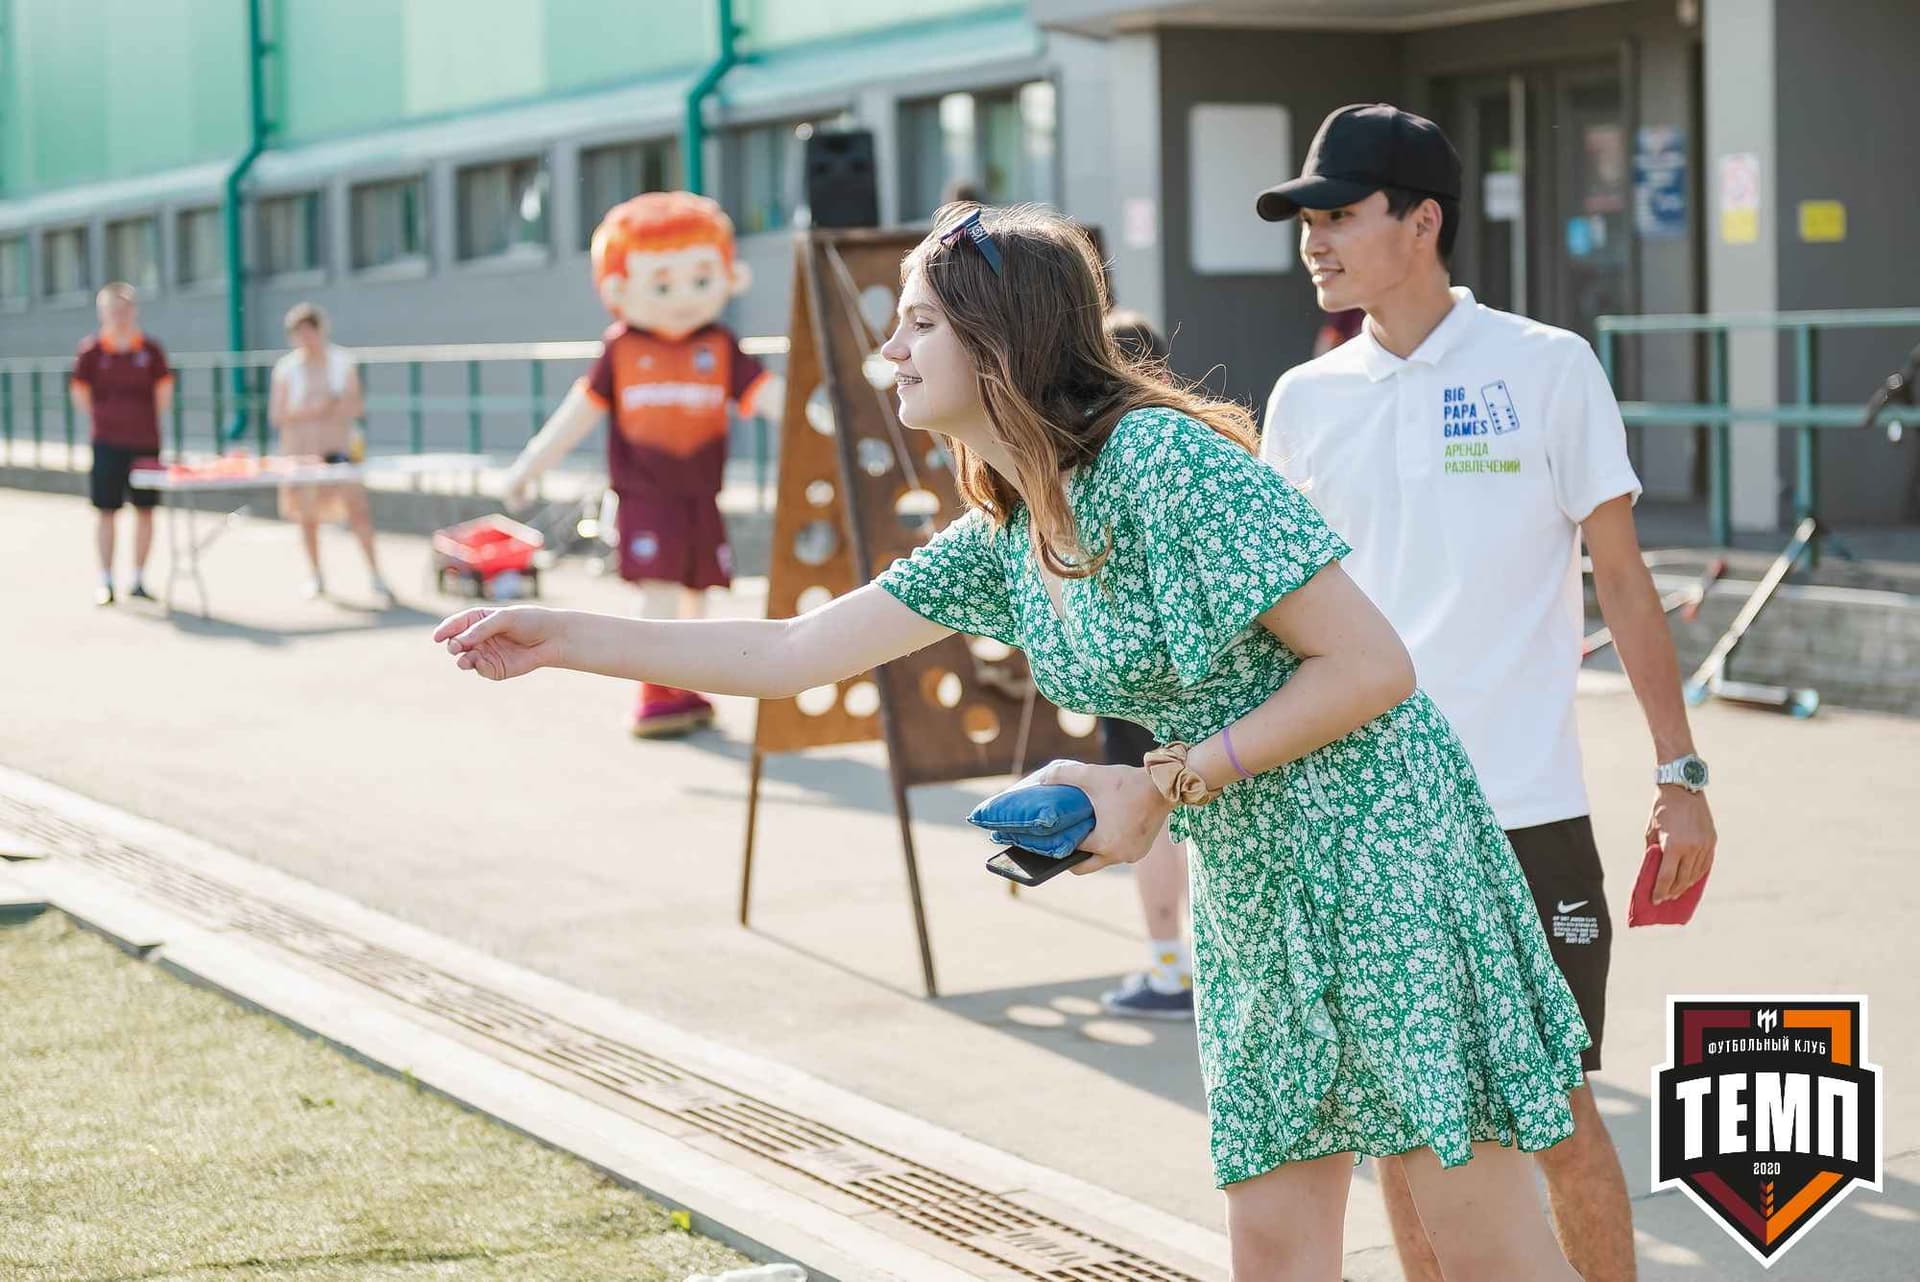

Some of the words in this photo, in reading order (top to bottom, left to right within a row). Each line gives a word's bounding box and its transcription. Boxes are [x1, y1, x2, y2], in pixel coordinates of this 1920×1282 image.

[1444, 386, 1465, 403] BIG
[1444, 403, 1477, 420] PAPA
[1444, 420, 1488, 438] GAMES
[1445, 442, 1489, 457] АРЕНДА
[1444, 458, 1521, 474] РАЗВЛЕЧЕНИЙ
